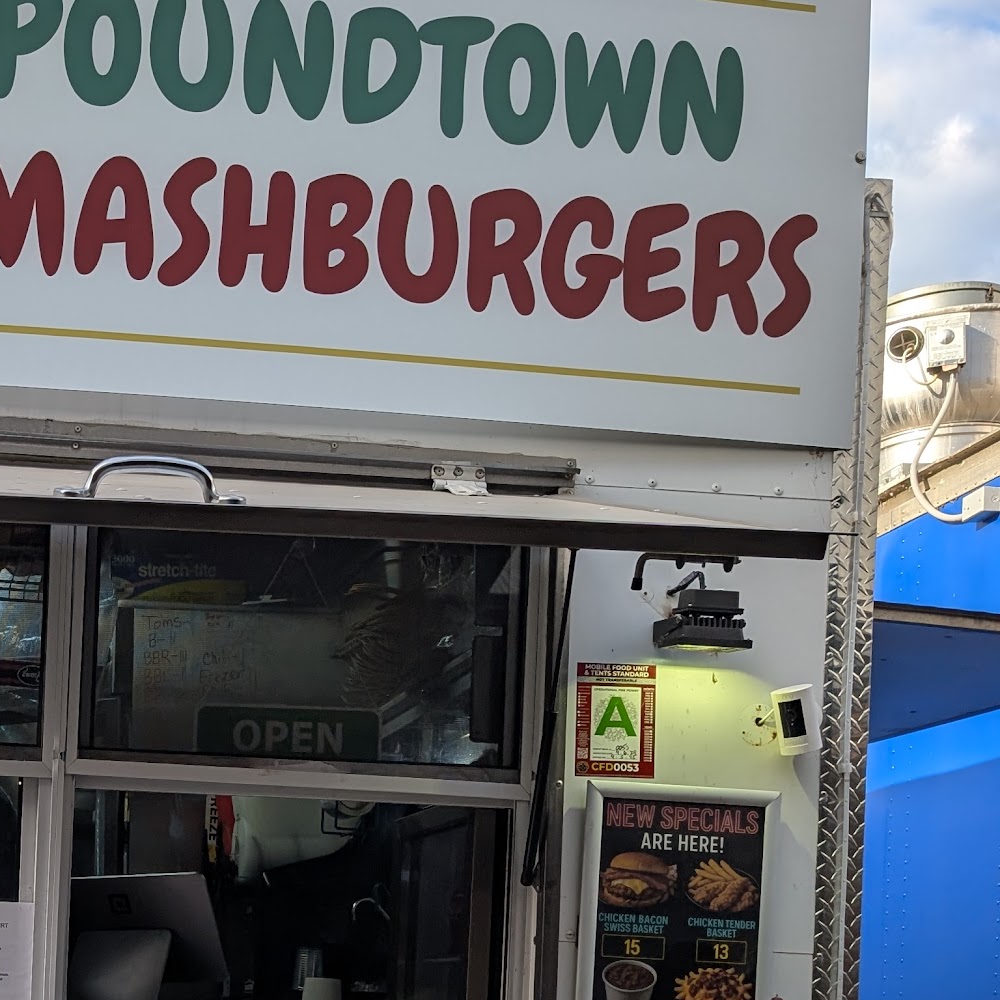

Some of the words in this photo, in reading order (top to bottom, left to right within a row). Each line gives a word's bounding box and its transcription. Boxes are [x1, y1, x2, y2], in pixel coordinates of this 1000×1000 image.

[595, 697, 636, 736] A
[232, 720, 343, 755] OPEN
[592, 763, 639, 772] CFD0053
[607, 803, 654, 828] NEW
[660, 805, 759, 834] SPECIALS
[641, 832, 672, 850] ARE
[678, 835, 724, 853] HERE!
[599, 913, 637, 923] CHICKEN
[638, 915, 668, 925] BACON
[688, 918, 725, 928] CHICKEN
[725, 920, 756, 930] TENDER
[604, 922, 631, 933] SWISS
[632, 924, 664, 934] BASKET
[706, 928, 737, 938] BASKET
[624, 939, 640, 955] 15
[713, 944, 729, 960] 13
